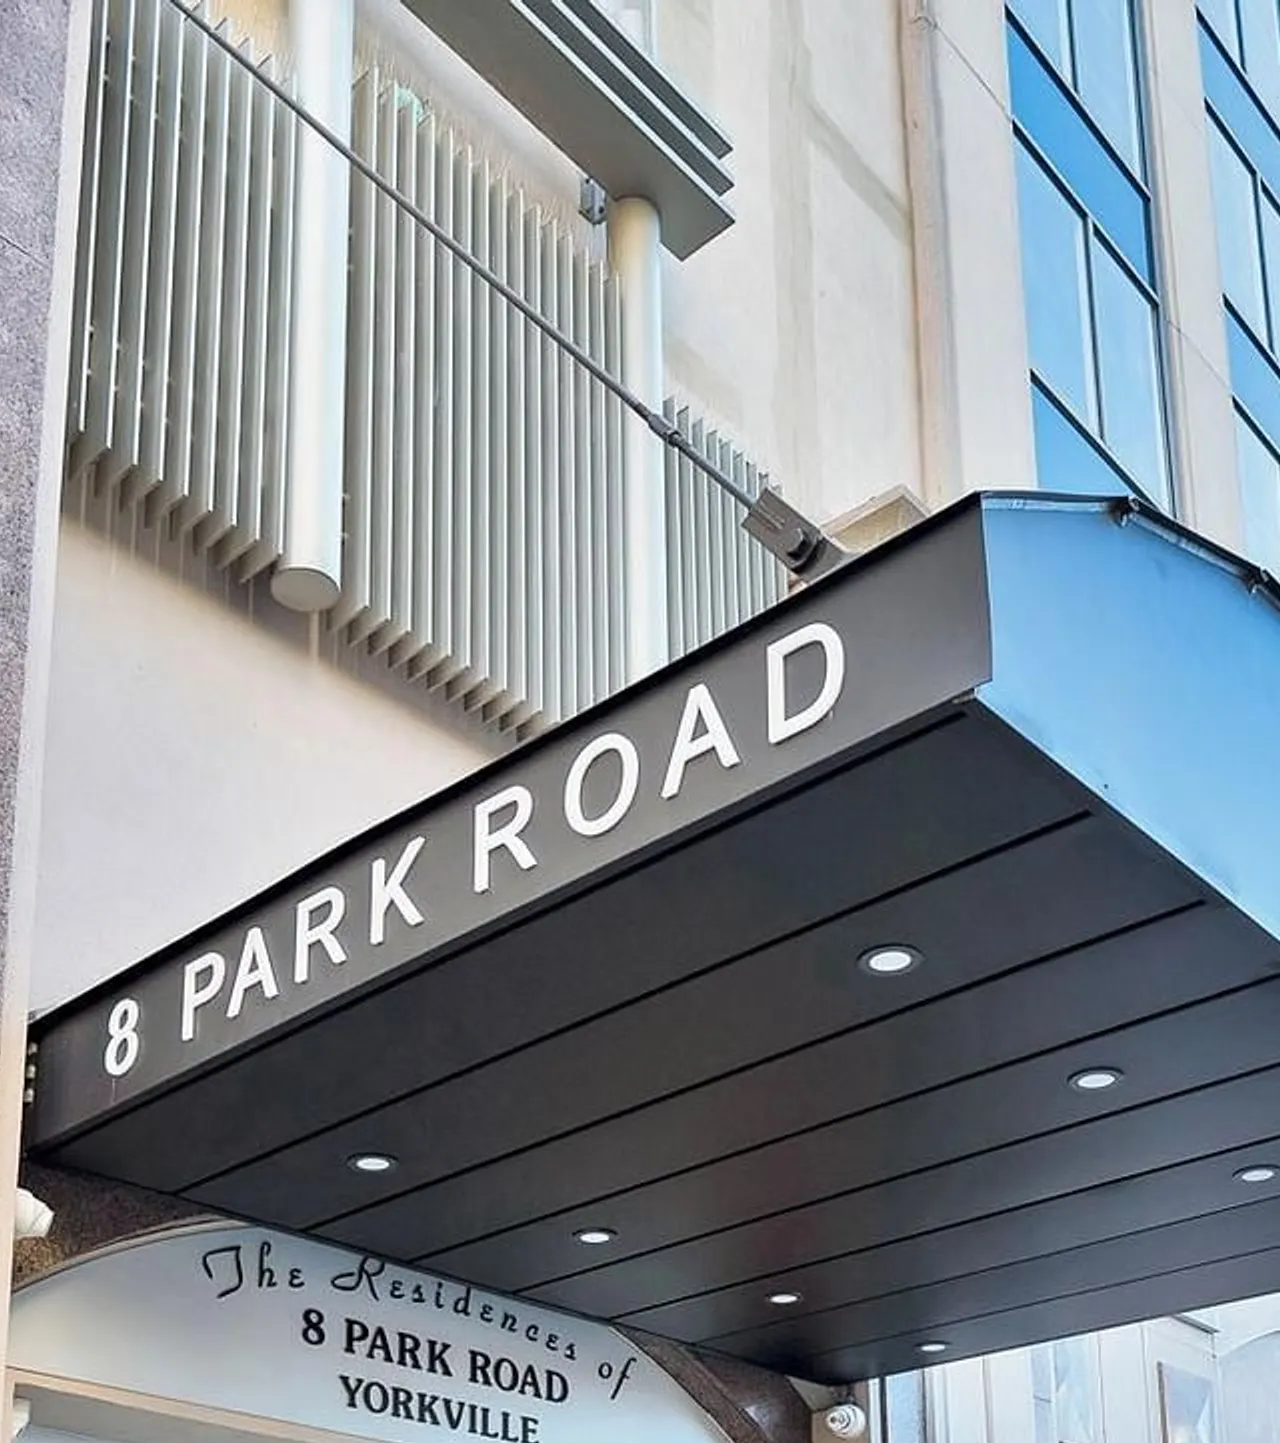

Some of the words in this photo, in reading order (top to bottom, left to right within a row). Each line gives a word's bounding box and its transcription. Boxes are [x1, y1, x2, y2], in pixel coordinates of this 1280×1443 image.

[103, 997, 140, 1077] 8
[180, 836, 426, 1041] PARK
[472, 621, 845, 893] ROAD
[201, 1240, 305, 1299] The
[330, 1255, 578, 1361] Residences
[597, 1357, 638, 1401] of
[300, 1308, 326, 1346] 8
[343, 1317, 454, 1378] PARK
[467, 1348, 570, 1404] ROAD
